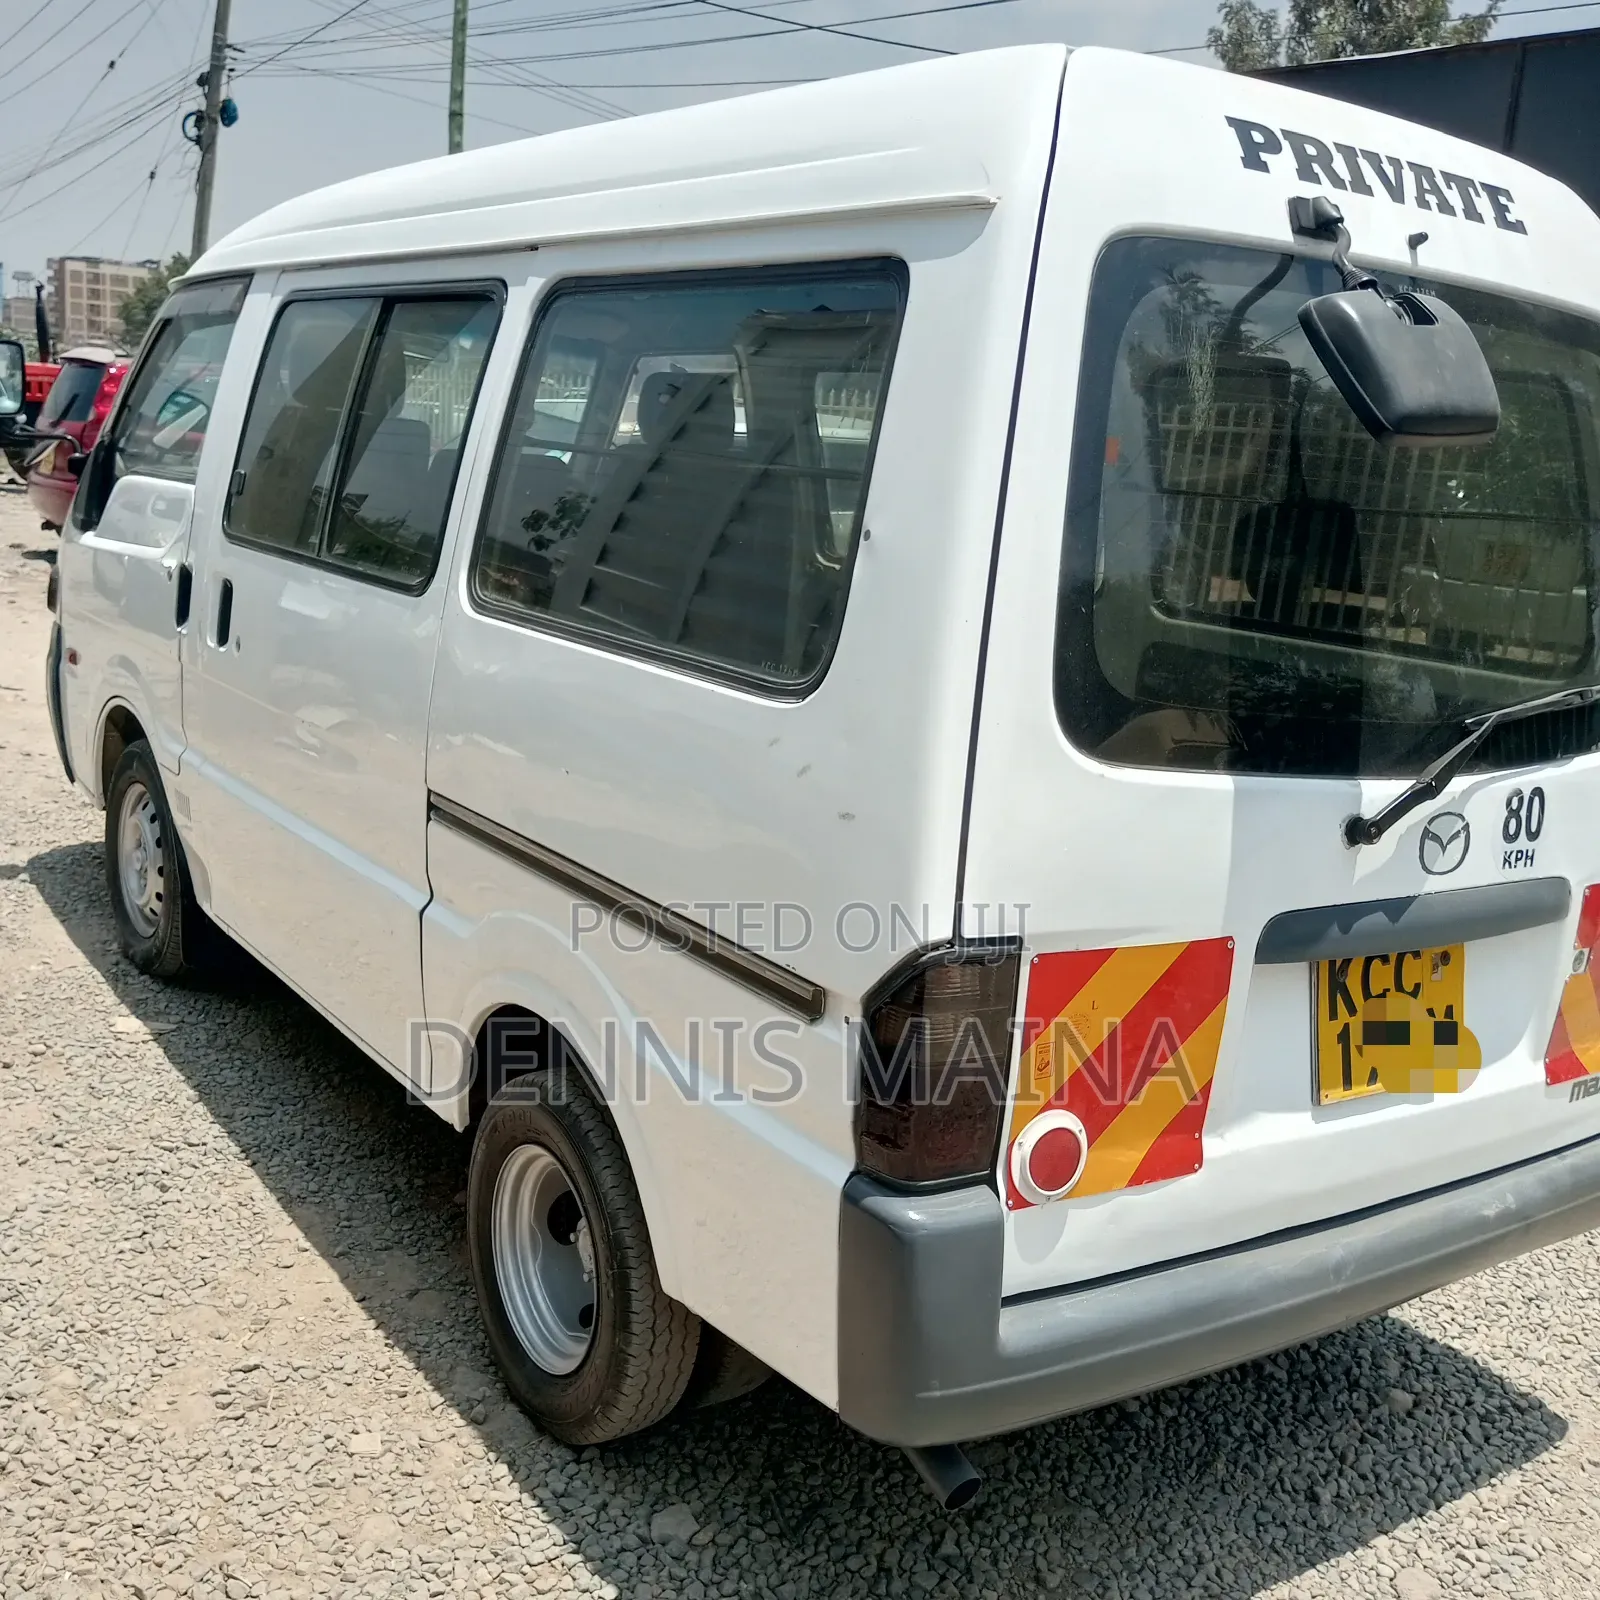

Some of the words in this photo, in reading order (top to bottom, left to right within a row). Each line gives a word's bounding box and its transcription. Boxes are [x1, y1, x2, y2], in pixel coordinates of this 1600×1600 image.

[1224, 115, 1528, 236] PRIVATE
[1502, 786, 1545, 844] 80
[1502, 848, 1535, 869] KPH
[1328, 950, 1421, 1021] KCC
[1568, 1076, 1600, 1103] ma
